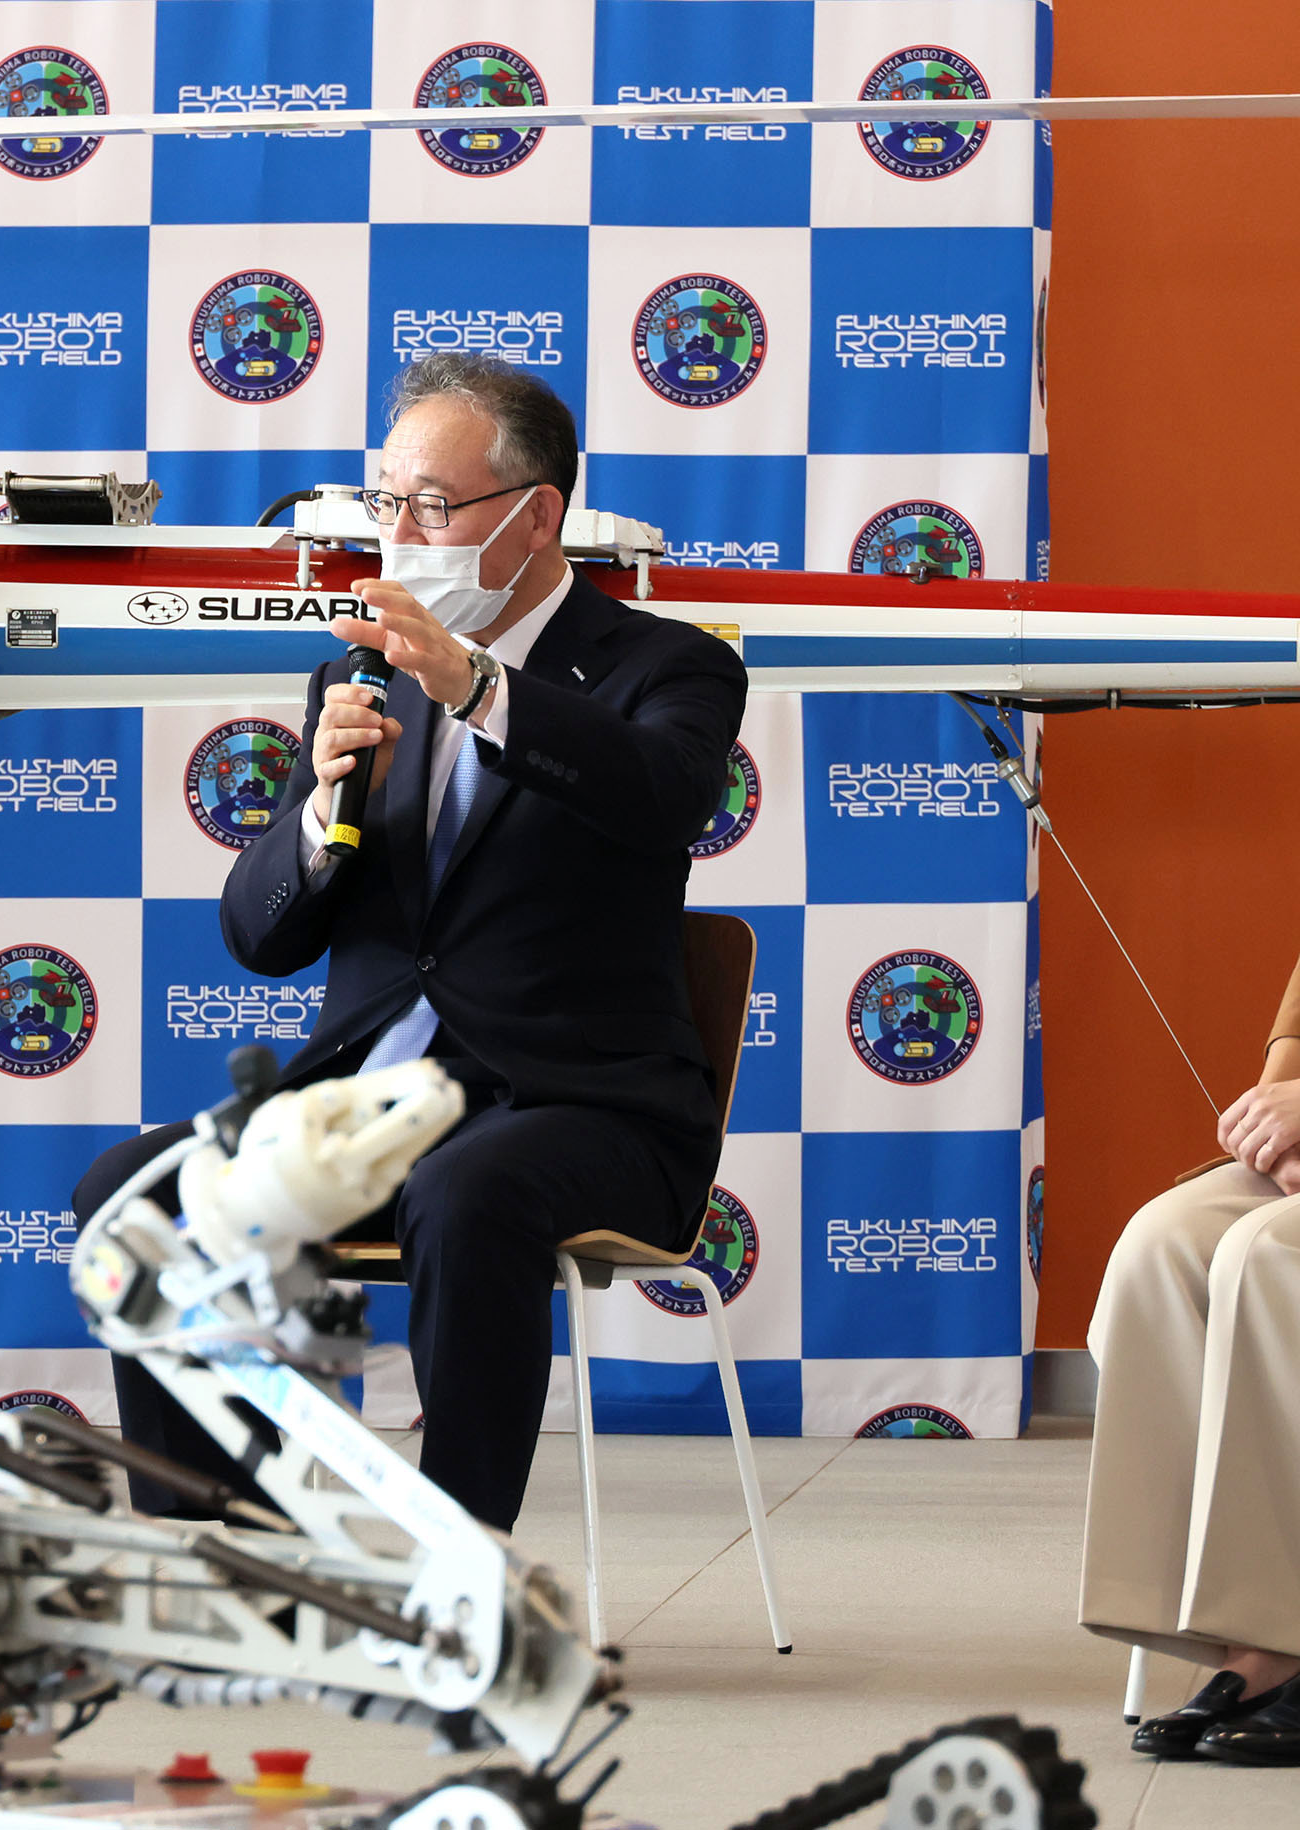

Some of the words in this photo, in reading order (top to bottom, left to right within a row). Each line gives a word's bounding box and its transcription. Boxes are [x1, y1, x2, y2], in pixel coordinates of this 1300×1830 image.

[903, 49, 945, 61] ROBOT
[948, 55, 975, 78] TEST
[179, 84, 347, 101] FUKUSHIMA
[618, 86, 787, 102] FUKUSHIMA
[618, 125, 695, 140] TEST
[705, 125, 787, 141] FIELD
[193, 279, 233, 339] FUKUSHIMA
[235, 273, 277, 285] ROBOT
[280, 279, 306, 302] TEST
[303, 302, 320, 337] FIELD
[636, 283, 676, 341] FUKUSHIMA
[678, 277, 720, 288] ROBOT
[723, 283, 750, 307] TEST
[746, 306, 763, 342] FIELD
[393, 310, 563, 327] FUKUSHIMA
[836, 314, 1006, 329] FUKUSHIMA
[393, 325, 563, 349] ROBOT
[836, 329, 1006, 352] ROBOT
[41, 351, 122, 366] FIELD
[836, 352, 913, 368] TEST
[924, 352, 1006, 368] FIELD
[852, 510, 894, 569] FUKUSHIMA
[896, 503, 937, 515] ROBOT
[941, 509, 967, 532] TEST
[963, 532, 980, 567] FIELD
[188, 728, 228, 786] FUKUSHIMA
[229, 721, 271, 733] ROBOT
[829, 763, 999, 779] FUKUSHIMA
[829, 779, 999, 801] ROBOT
[36, 796, 117, 813] FIELD
[830, 801, 907, 817] TEST
[918, 801, 1000, 817] FIELD
[9, 948, 51, 959] ROBOT
[54, 954, 81, 977] TEST
[77, 976, 94, 1012] FIELD
[851, 959, 891, 1019] FUKUSHIMA
[893, 953, 935, 965] ROBOT
[939, 959, 965, 982] TEST
[962, 982, 979, 1018] FIELD
[167, 1023, 243, 1039] TEST
[254, 1023, 311, 1039] FIEL
[714, 1190, 741, 1213] TEST
[737, 1213, 755, 1248] FIELD
[827, 1218, 997, 1235] FUKUSHIMA
[827, 1235, 997, 1257] ROBOT
[828, 1258, 904, 1273] TEST
[916, 1257, 997, 1273] FIELD
[892, 1407, 934, 1418] ROBOT
[937, 1413, 964, 1437] TEST
